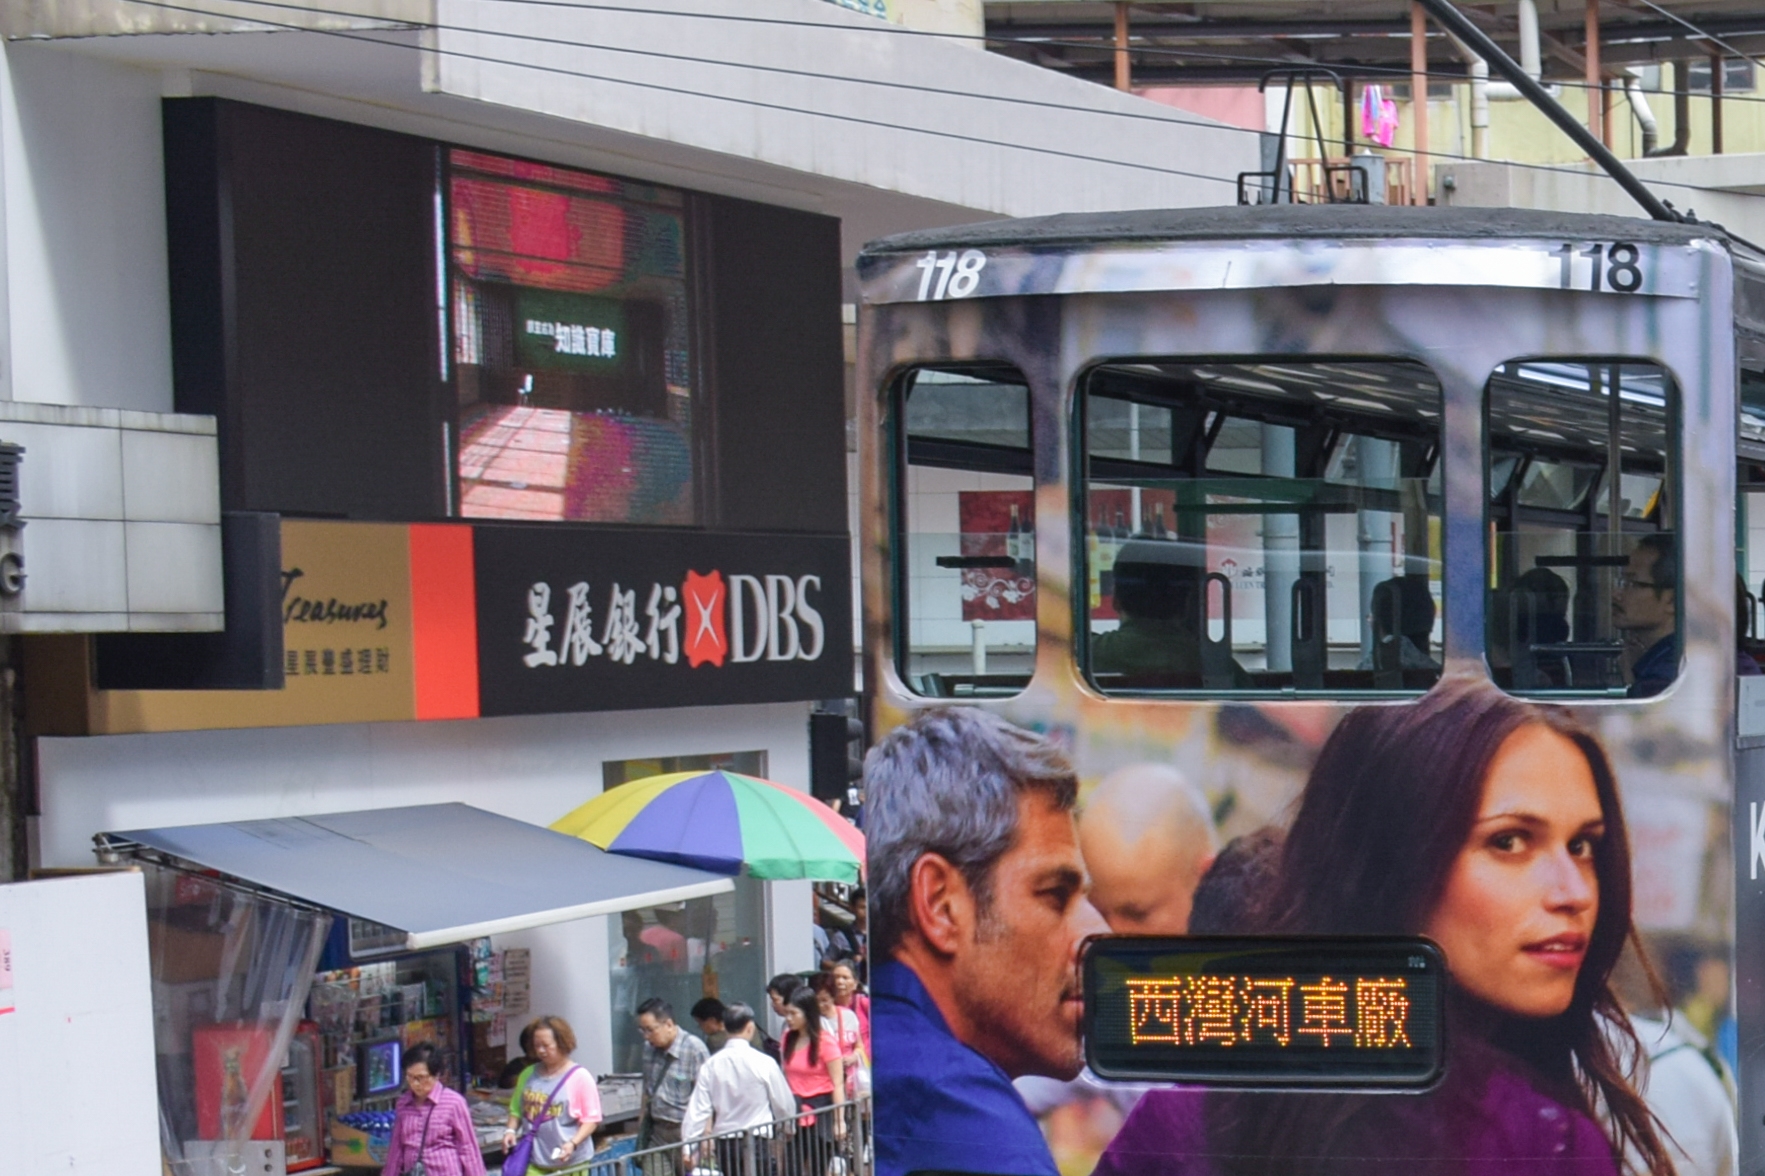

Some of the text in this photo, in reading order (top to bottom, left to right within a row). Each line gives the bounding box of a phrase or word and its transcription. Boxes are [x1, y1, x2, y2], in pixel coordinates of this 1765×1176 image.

[916, 249, 987, 301] 118
[1548, 242, 1643, 292] 118
[522, 581, 681, 668] 星展銀行
[728, 574, 825, 663] DBS
[1126, 975, 1411, 1047] 西灣河車廠
